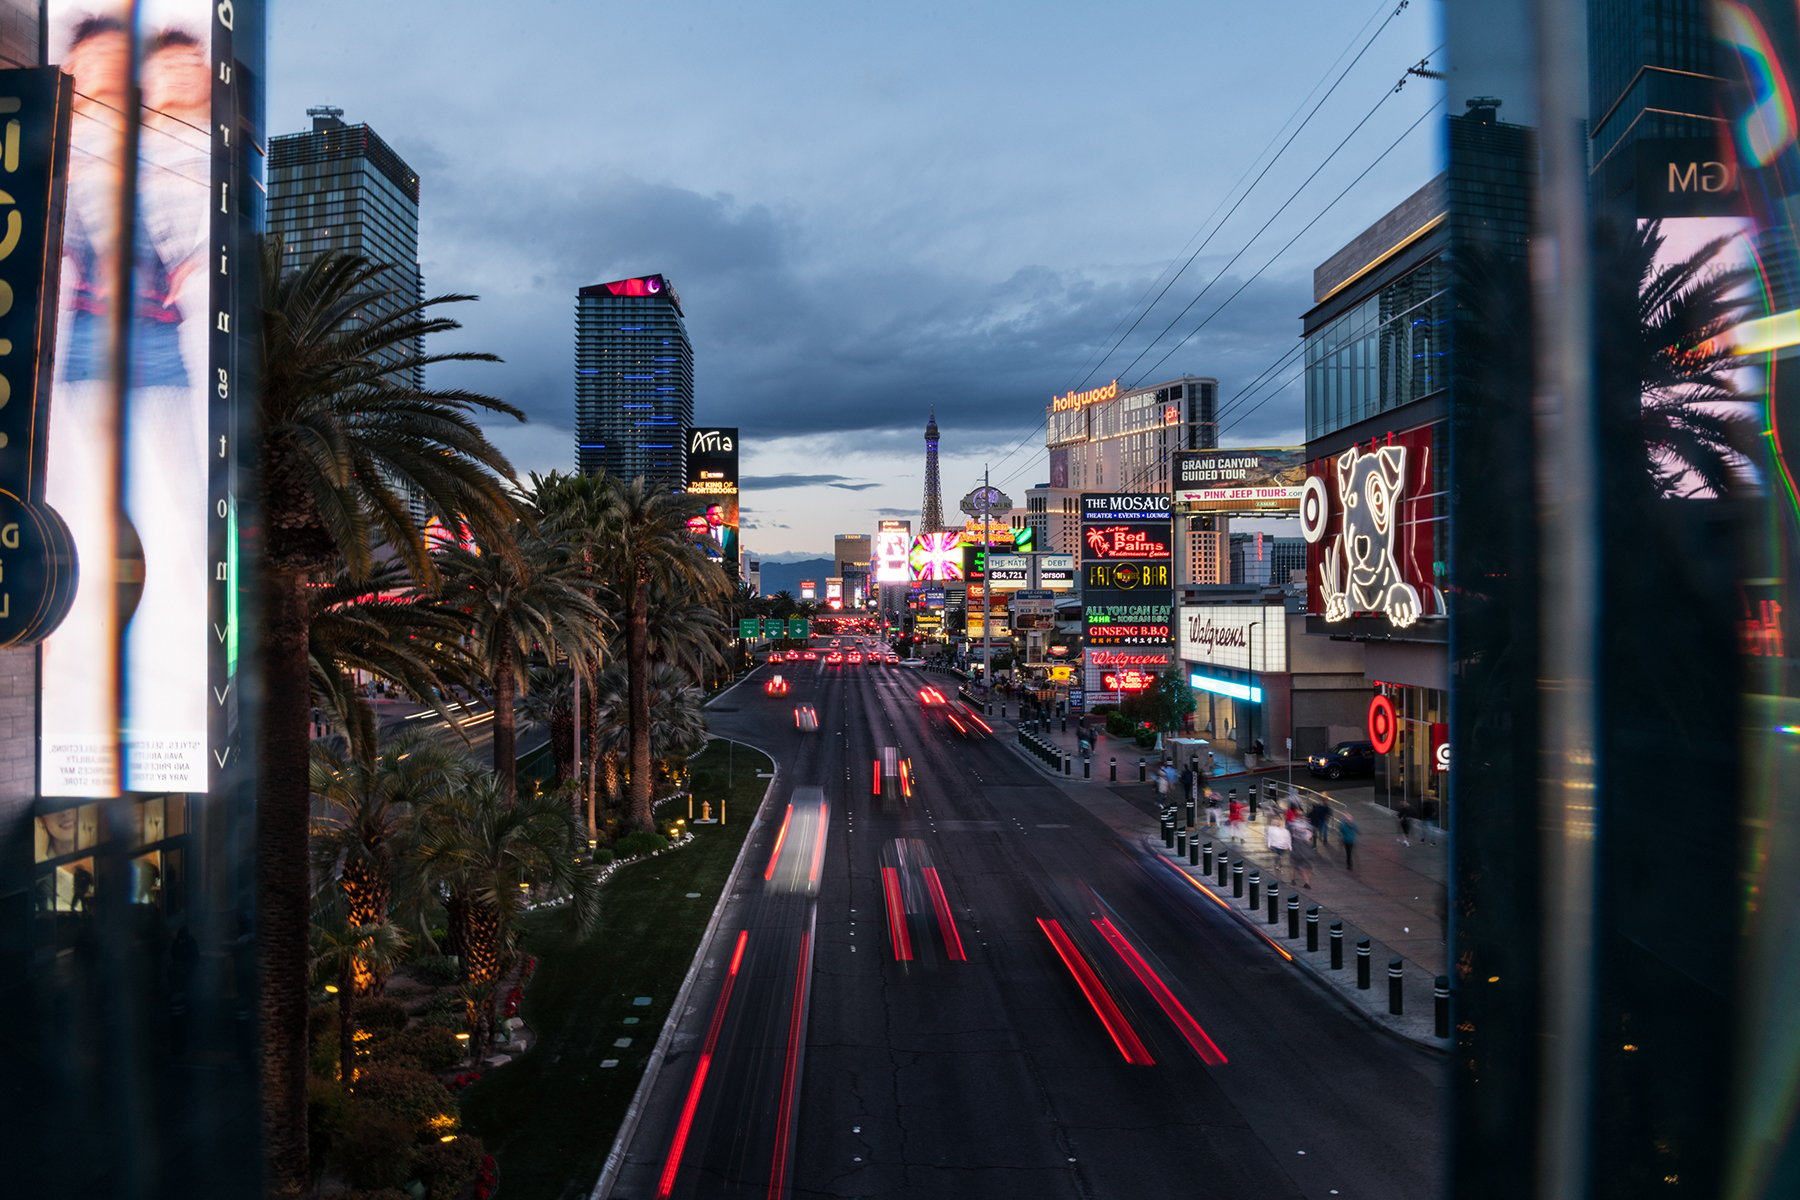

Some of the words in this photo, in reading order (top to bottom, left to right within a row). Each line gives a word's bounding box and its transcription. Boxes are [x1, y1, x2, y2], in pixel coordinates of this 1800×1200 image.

[1053, 380, 1117, 412] hollywood
[692, 431, 733, 453] Aria
[1182, 460, 1215, 470] GRAND
[1218, 457, 1258, 469] CANYON
[1182, 470, 1217, 481] GUIDED
[1220, 469, 1246, 480] TOUR
[1204, 490, 1226, 499] PINK
[1229, 489, 1252, 499] JEEP
[1086, 499, 1107, 508] THE
[1110, 496, 1170, 510] MOSAIC
[1115, 532, 1146, 541] Red
[1115, 541, 1164, 551] Palms
[992, 571, 1023, 580] $84,721
[1091, 566, 1111, 586] FAT
[1143, 566, 1167, 586] BAR
[1086, 606, 1104, 616] ALL
[1106, 606, 1127, 615] YOU
[1129, 606, 1150, 615] CAN
[1152, 606, 1171, 615] EAT
[1089, 626, 1138, 636] GINSENG
[1188, 613, 1247, 655] Walgreens
[1091, 650, 1169, 668] Walgreens
